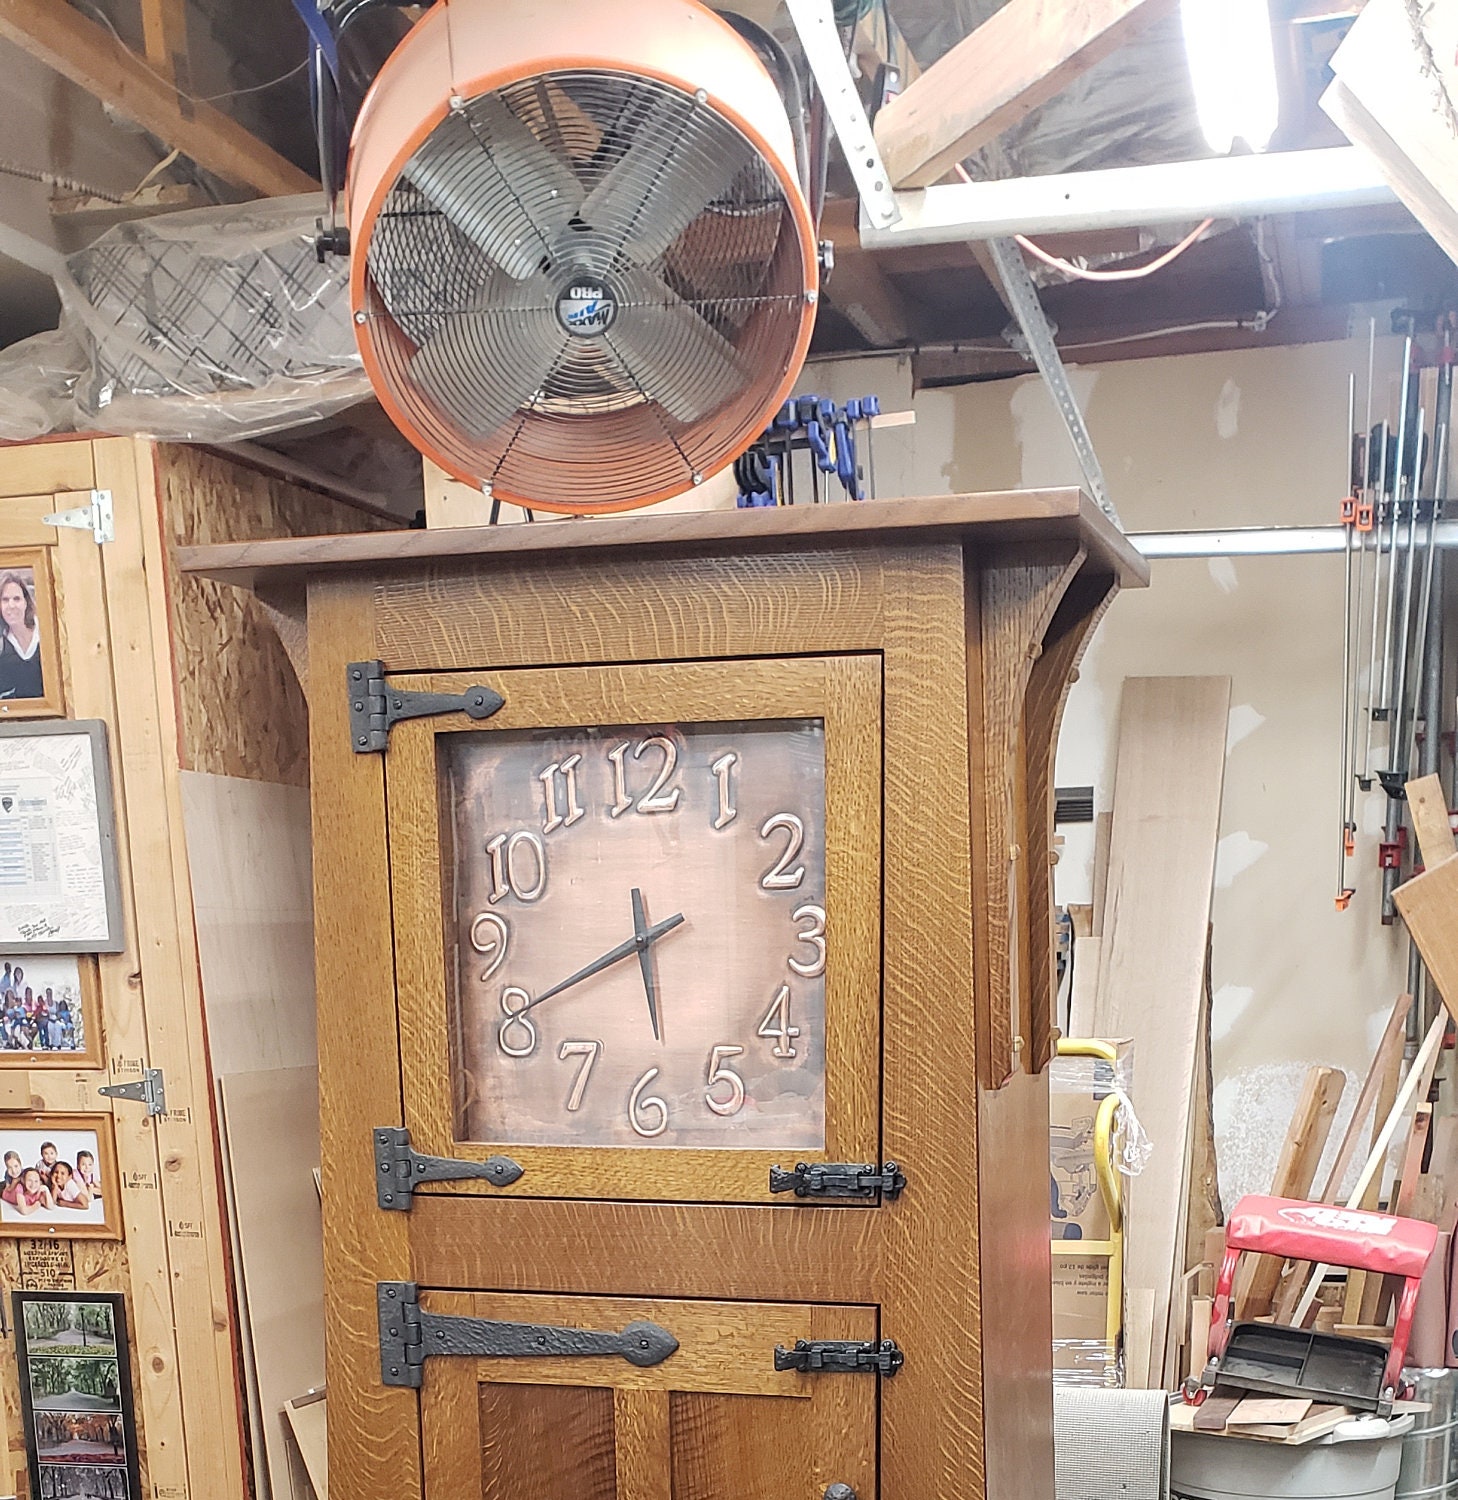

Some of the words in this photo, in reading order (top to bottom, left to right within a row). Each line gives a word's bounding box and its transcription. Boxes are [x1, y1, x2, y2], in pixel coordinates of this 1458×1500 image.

[570, 287, 603, 299] PRO
[539, 753, 585, 834] 11
[609, 736, 681, 819] 12
[711, 752, 739, 830] 1
[487, 830, 547, 904] 10
[760, 812, 805, 891] 2
[470, 911, 508, 982] 9
[788, 904, 827, 978] 3
[498, 987, 537, 1057] 8
[758, 986, 800, 1058] 4
[559, 1039, 602, 1112] 7
[628, 1067, 668, 1137] 6
[705, 1045, 745, 1116] 5
[40, 1269, 56, 1277] 510
